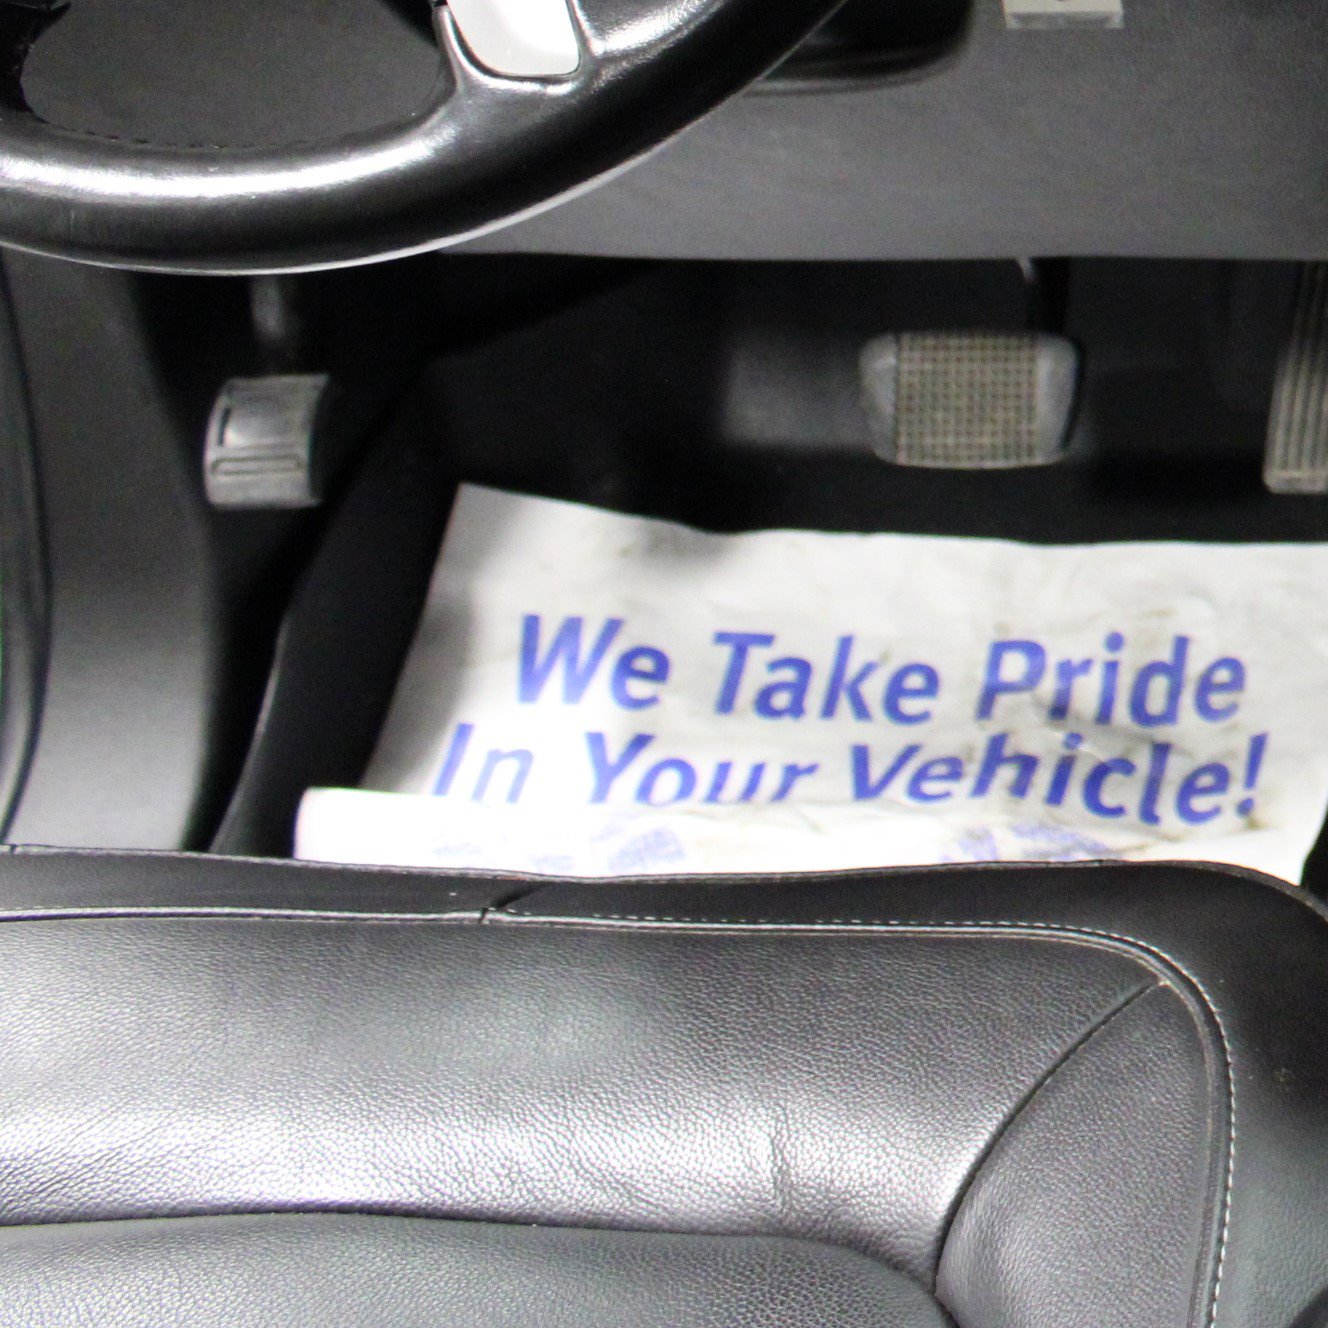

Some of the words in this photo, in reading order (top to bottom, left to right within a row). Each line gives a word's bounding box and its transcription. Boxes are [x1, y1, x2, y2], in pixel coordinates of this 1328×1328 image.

[517, 614, 671, 711] We
[711, 630, 941, 726] Take
[974, 629, 1250, 731] Pride
[430, 722, 536, 804] In
[583, 731, 821, 806] Your
[849, 732, 1269, 827] Vehicle!
